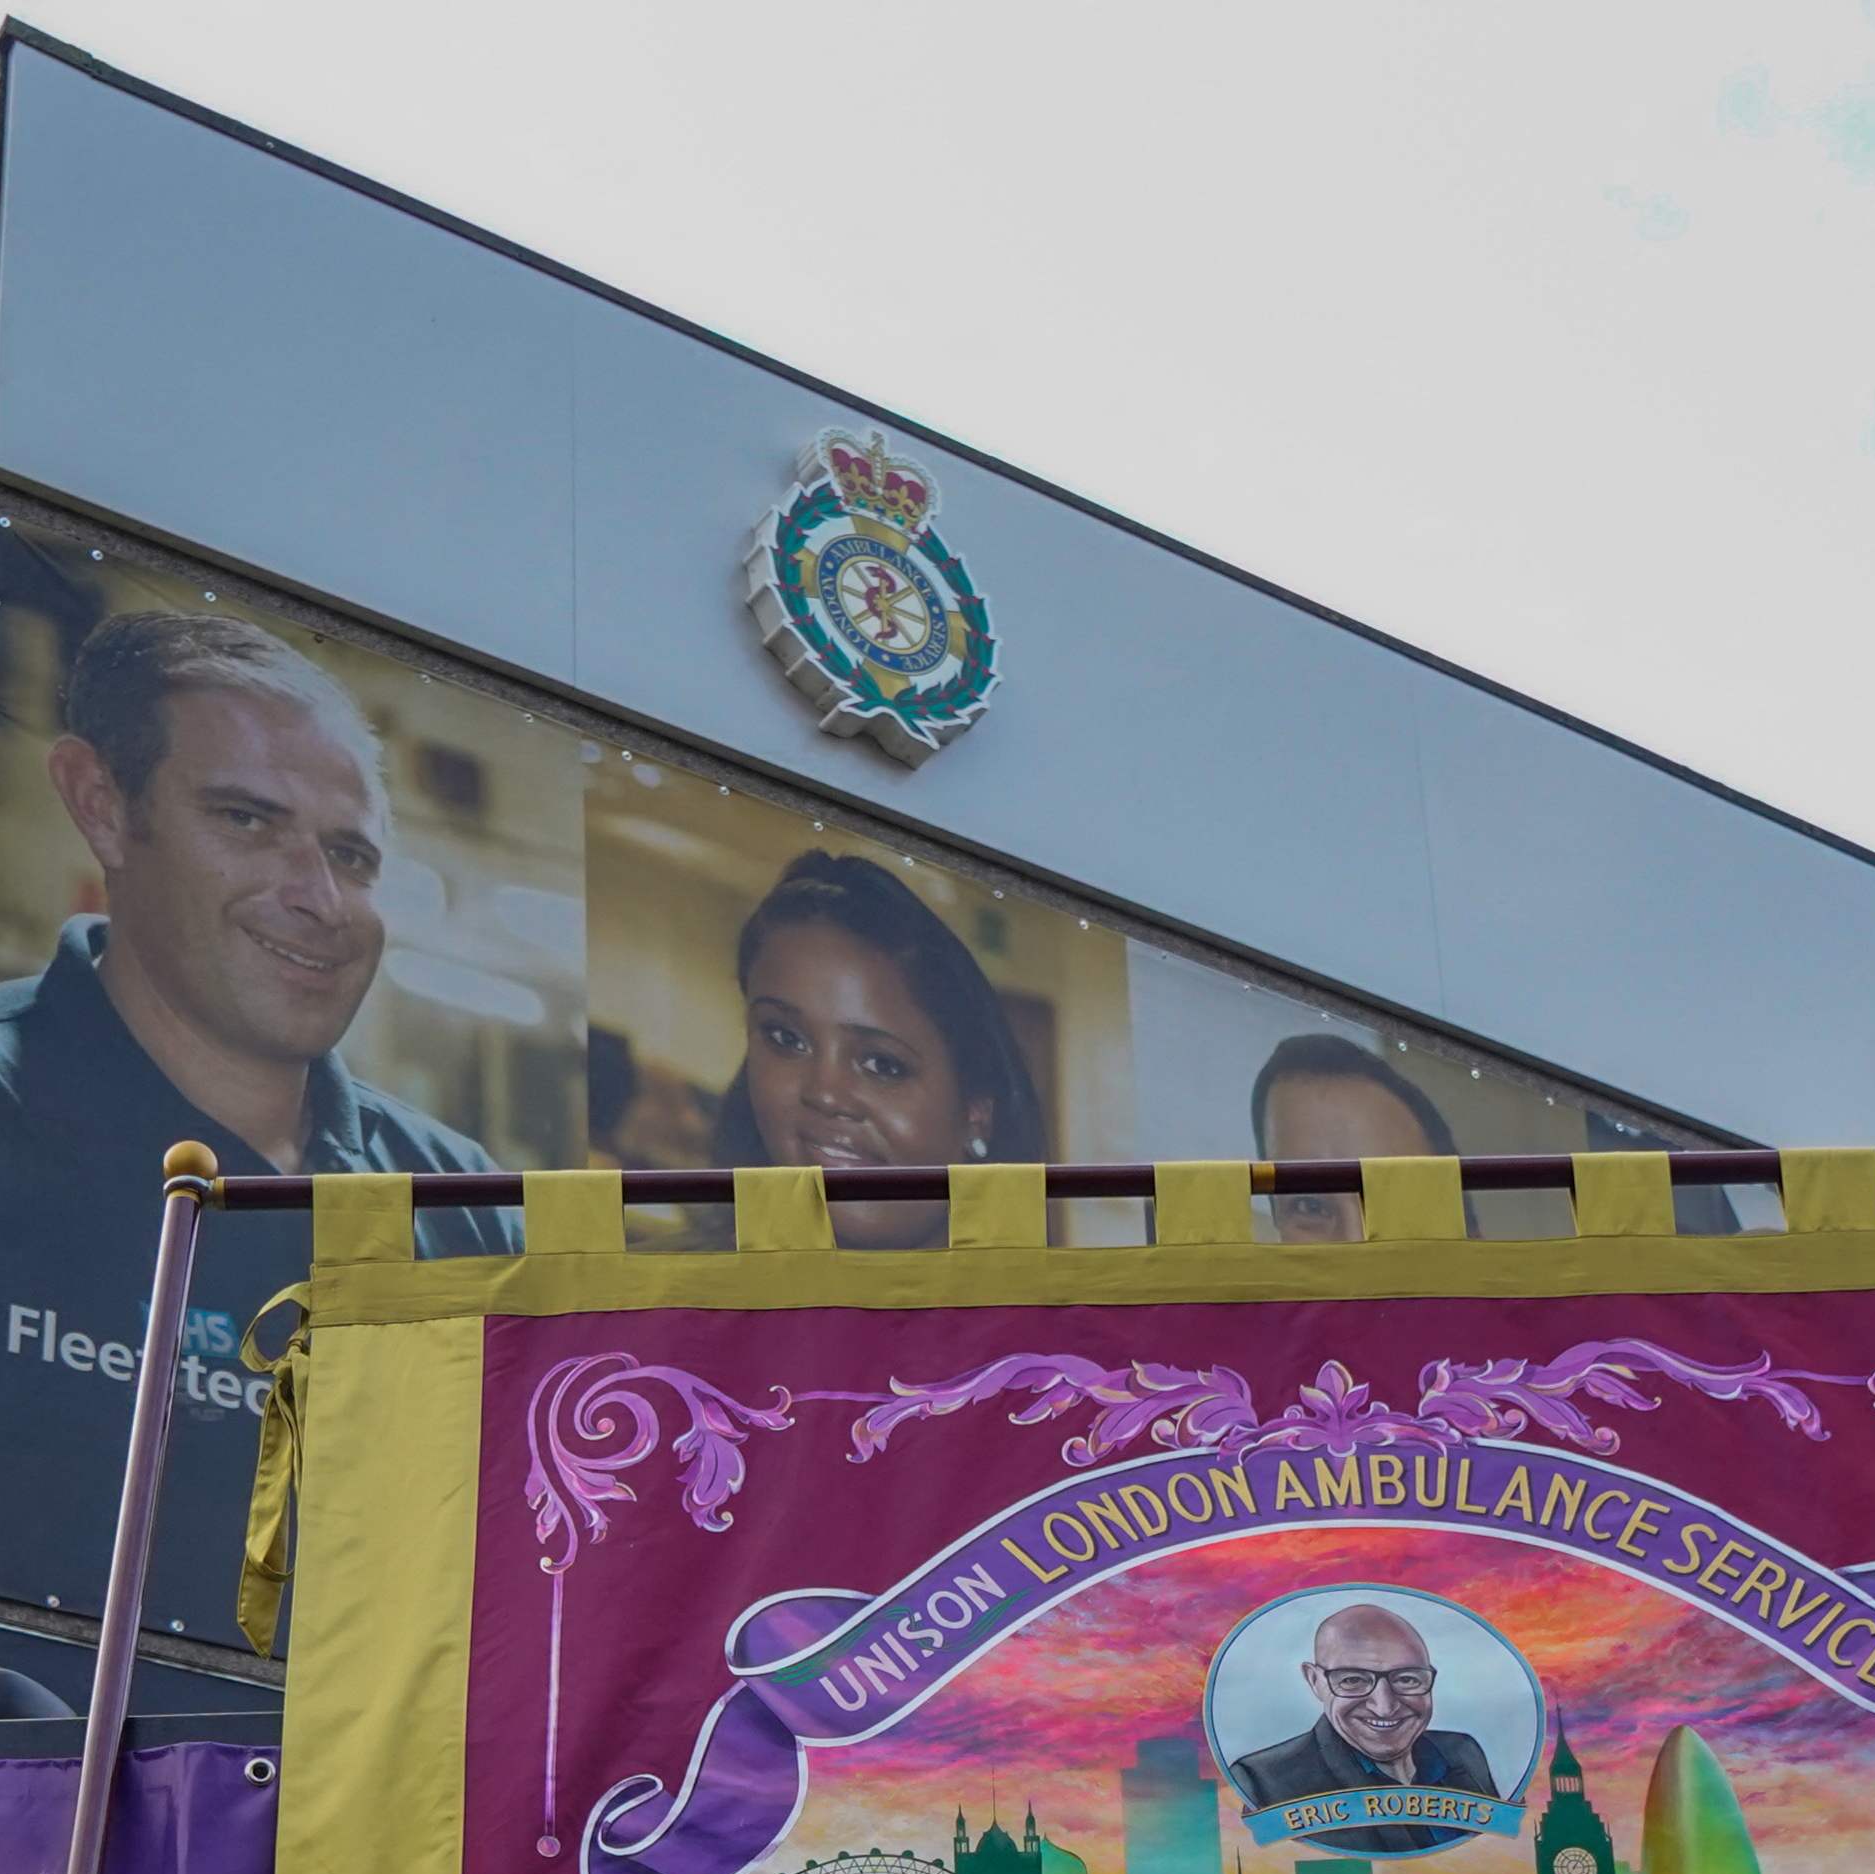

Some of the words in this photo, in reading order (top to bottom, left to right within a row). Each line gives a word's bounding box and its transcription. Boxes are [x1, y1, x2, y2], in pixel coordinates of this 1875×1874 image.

[8, 1303, 145, 1383] Flee
[181, 1312, 235, 1354] HS
[819, 1562, 1006, 1712] UNISON
[1000, 1465, 1257, 1585] LONDON
[1274, 1454, 1670, 1558] AMBULANCE
[1283, 1799, 1350, 1831] ERIC
[1365, 1795, 1494, 1824] ROBERTS
